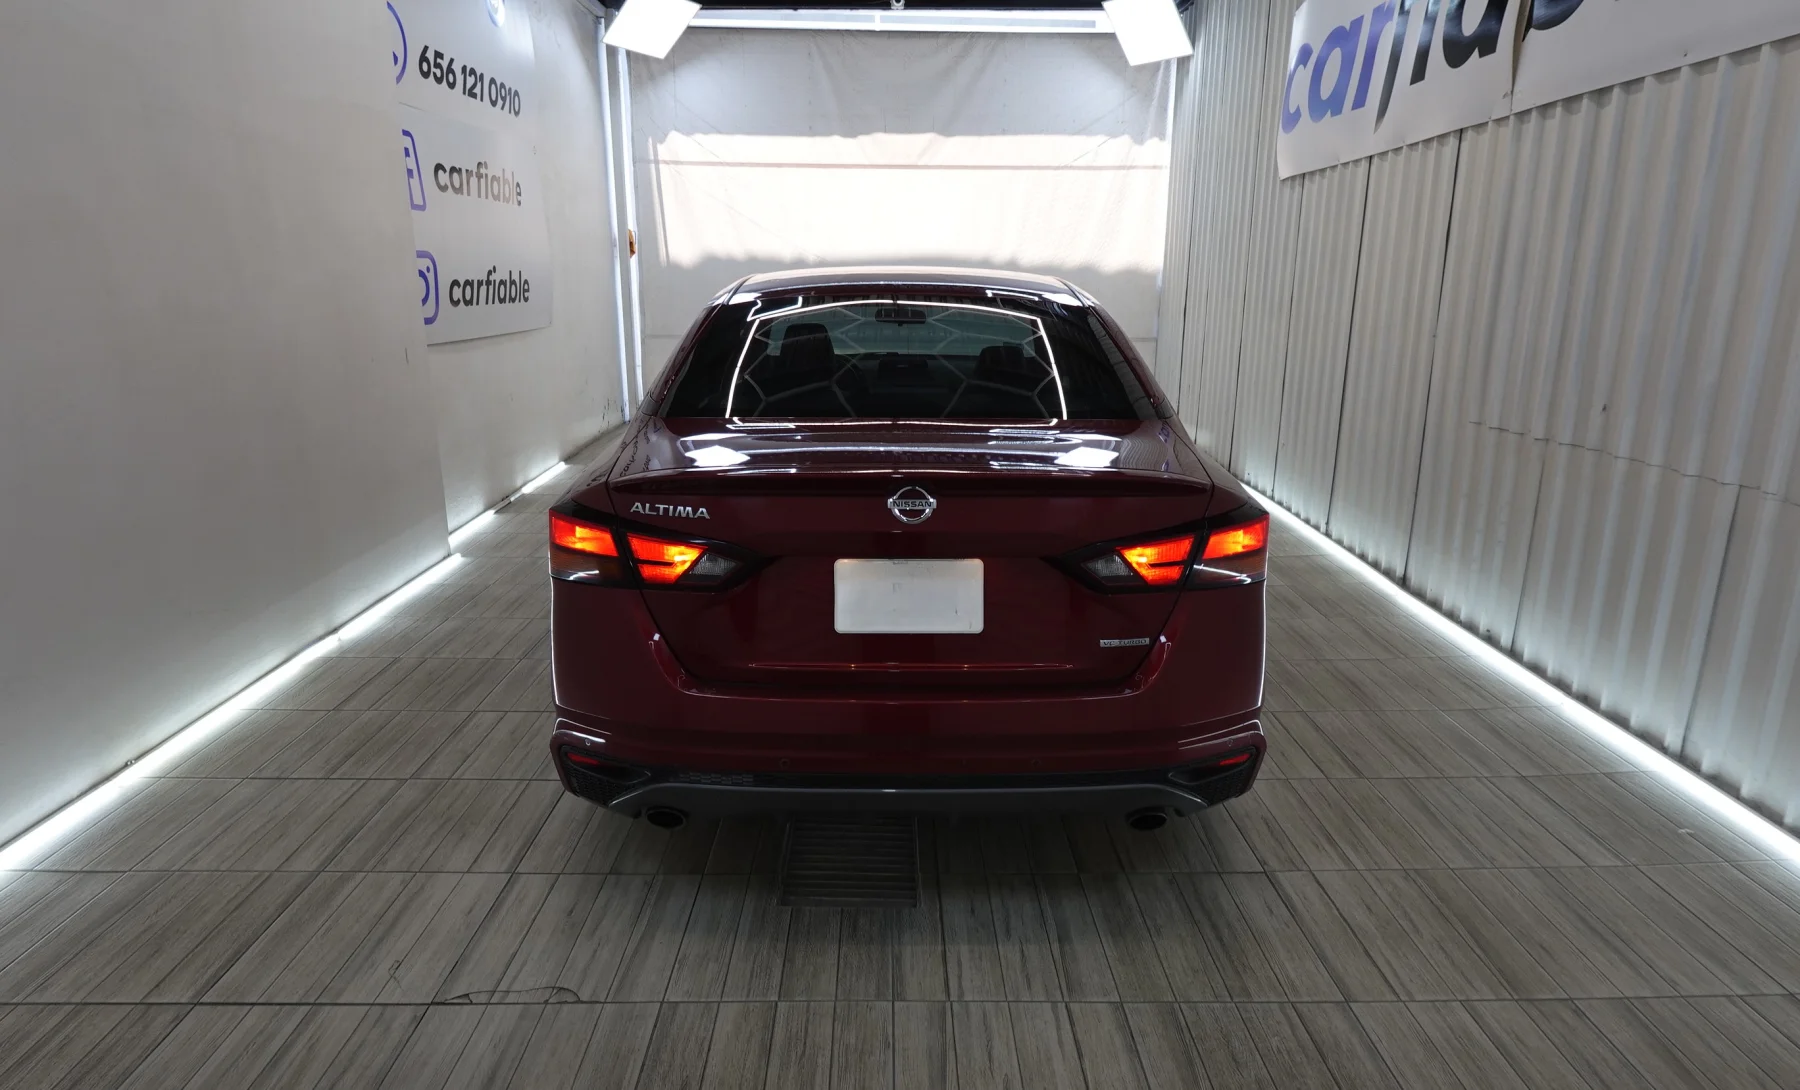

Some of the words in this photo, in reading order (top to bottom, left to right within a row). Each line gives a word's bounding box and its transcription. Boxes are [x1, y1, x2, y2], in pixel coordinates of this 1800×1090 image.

[418, 45, 457, 90] 656
[461, 64, 484, 102] 121
[488, 77, 521, 118] 0910
[433, 161, 521, 206] carfiable
[449, 265, 530, 307] carfiable
[630, 501, 711, 520] ALTIMA
